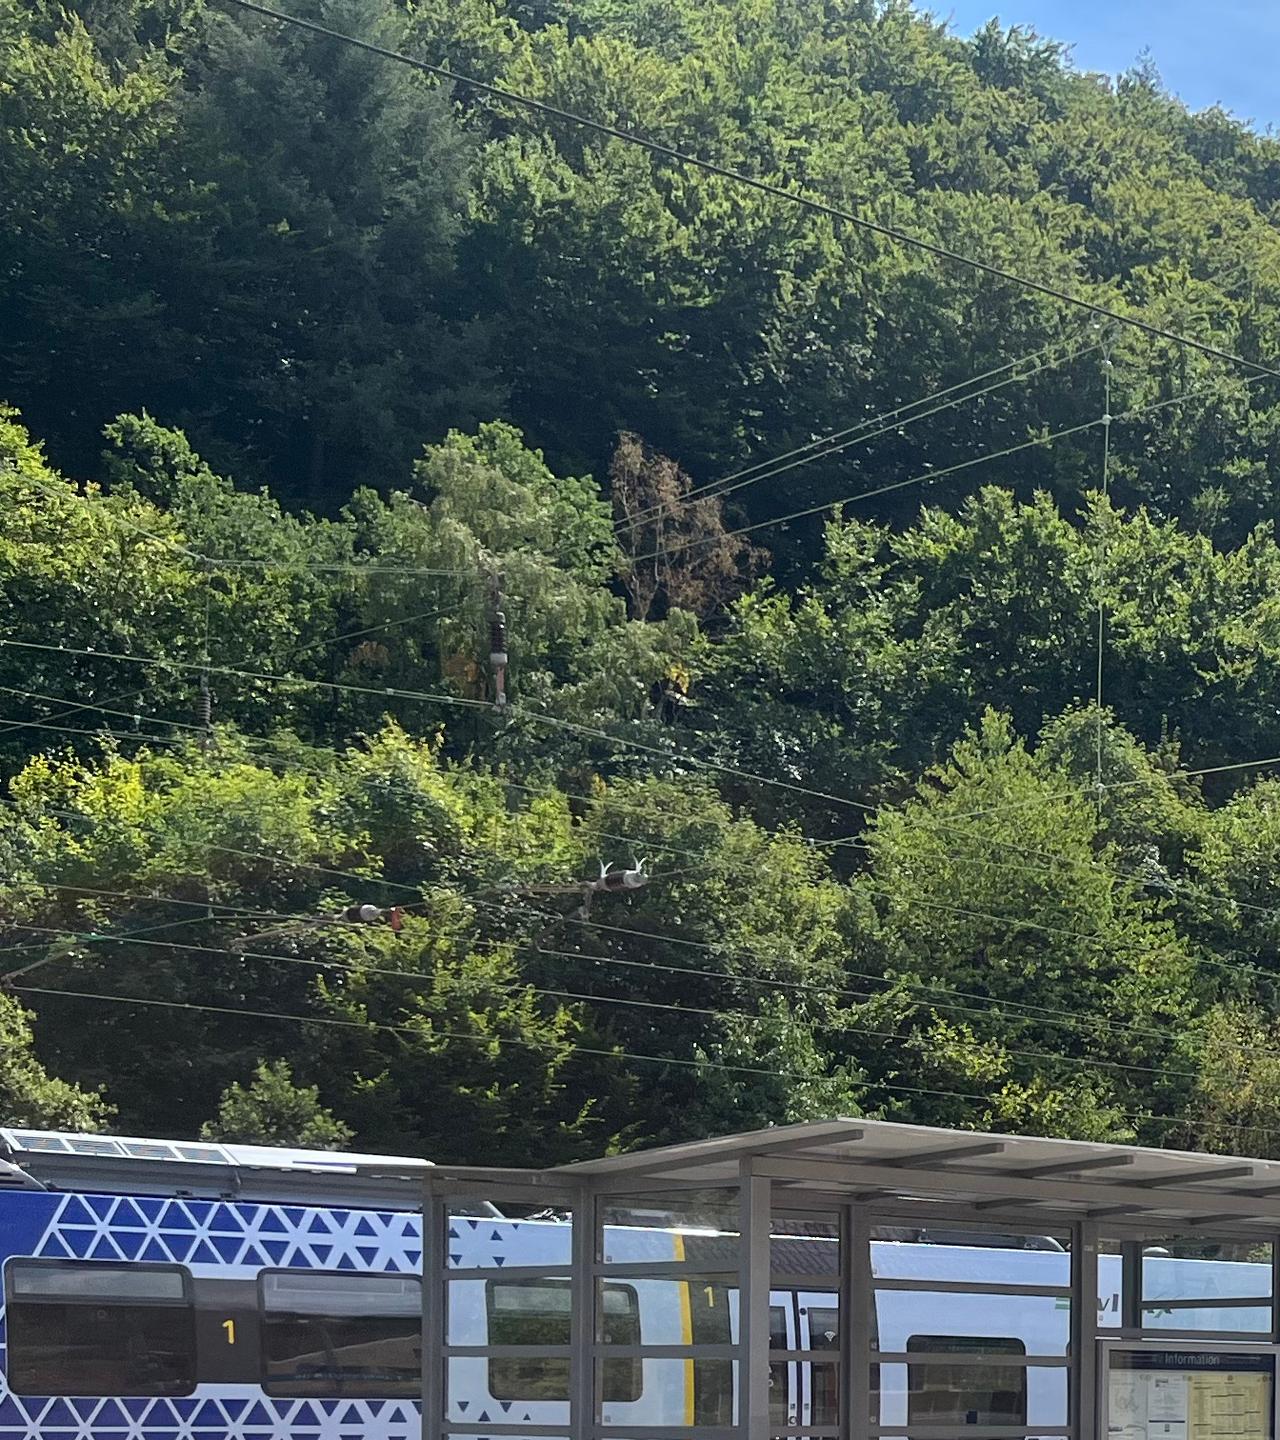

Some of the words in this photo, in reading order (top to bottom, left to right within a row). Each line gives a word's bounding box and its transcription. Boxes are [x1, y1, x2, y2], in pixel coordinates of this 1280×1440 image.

[703, 1286, 715, 1308] 1
[222, 1319, 235, 1344] 1
[1164, 1352, 1220, 1365] Information
